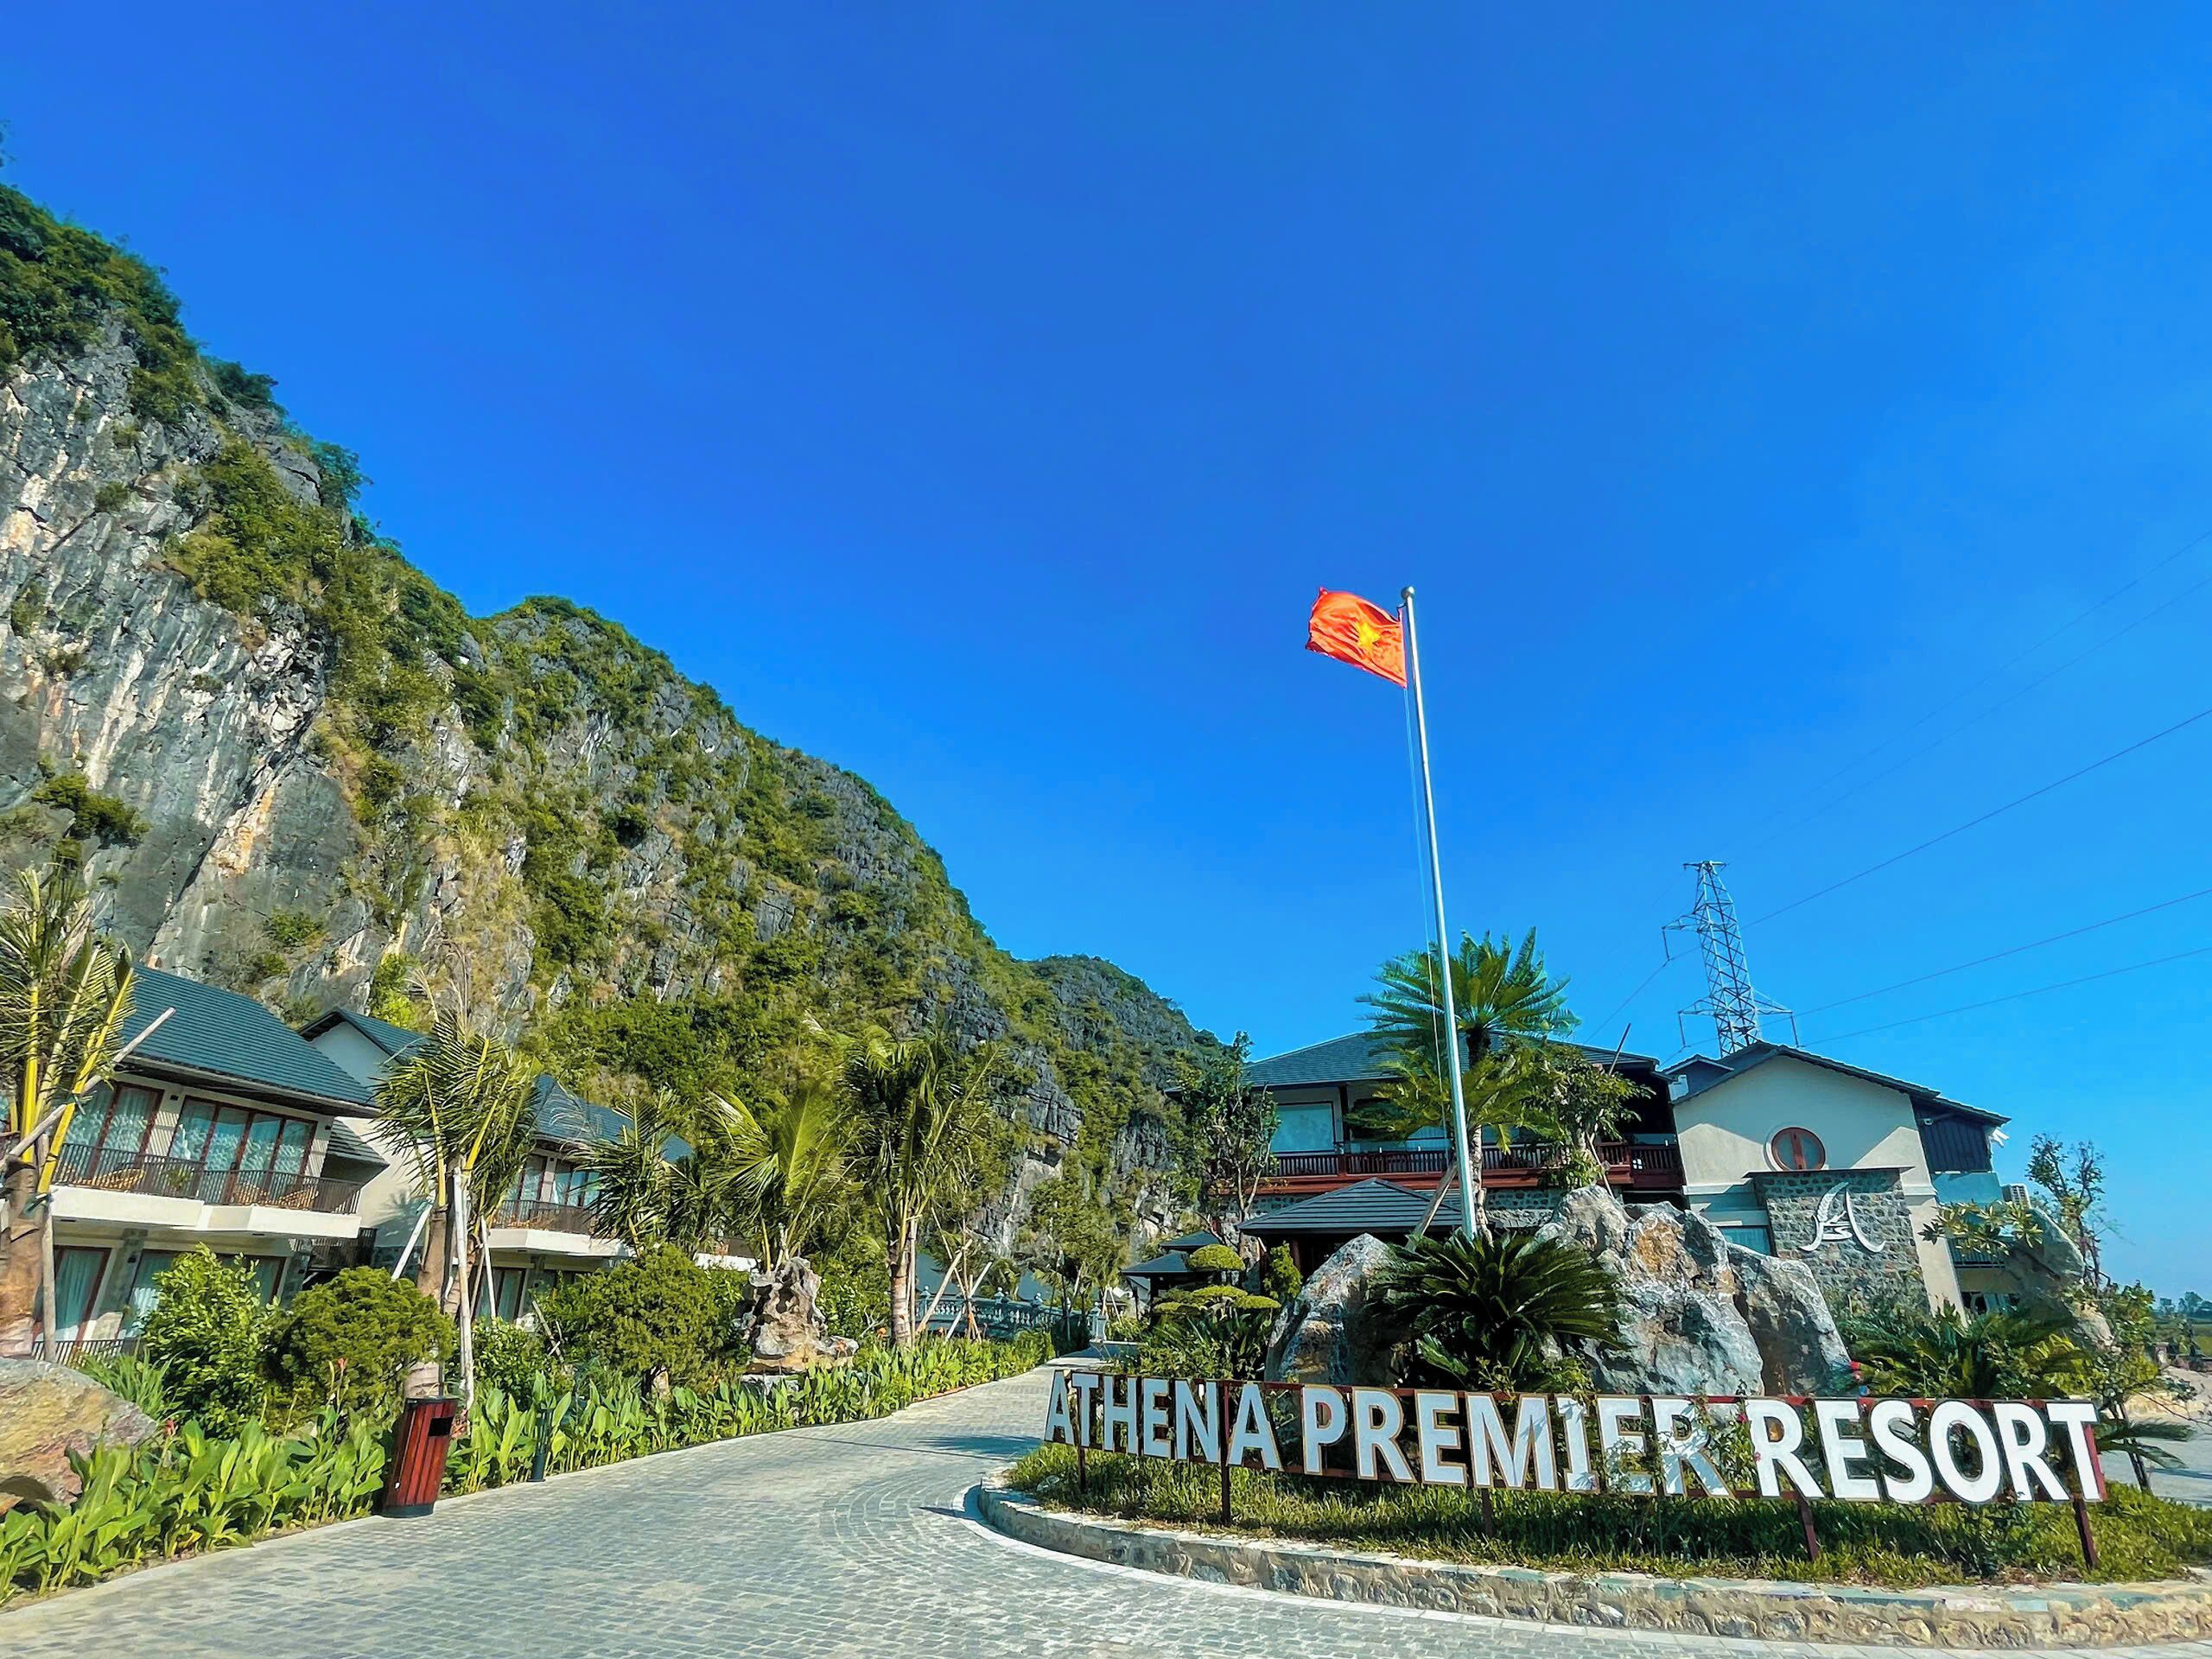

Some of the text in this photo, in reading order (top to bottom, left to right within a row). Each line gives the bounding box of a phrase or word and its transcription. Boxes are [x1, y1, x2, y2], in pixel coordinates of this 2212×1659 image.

[1044, 1370, 2103, 1504] ATHENA PREMIER RESORT
